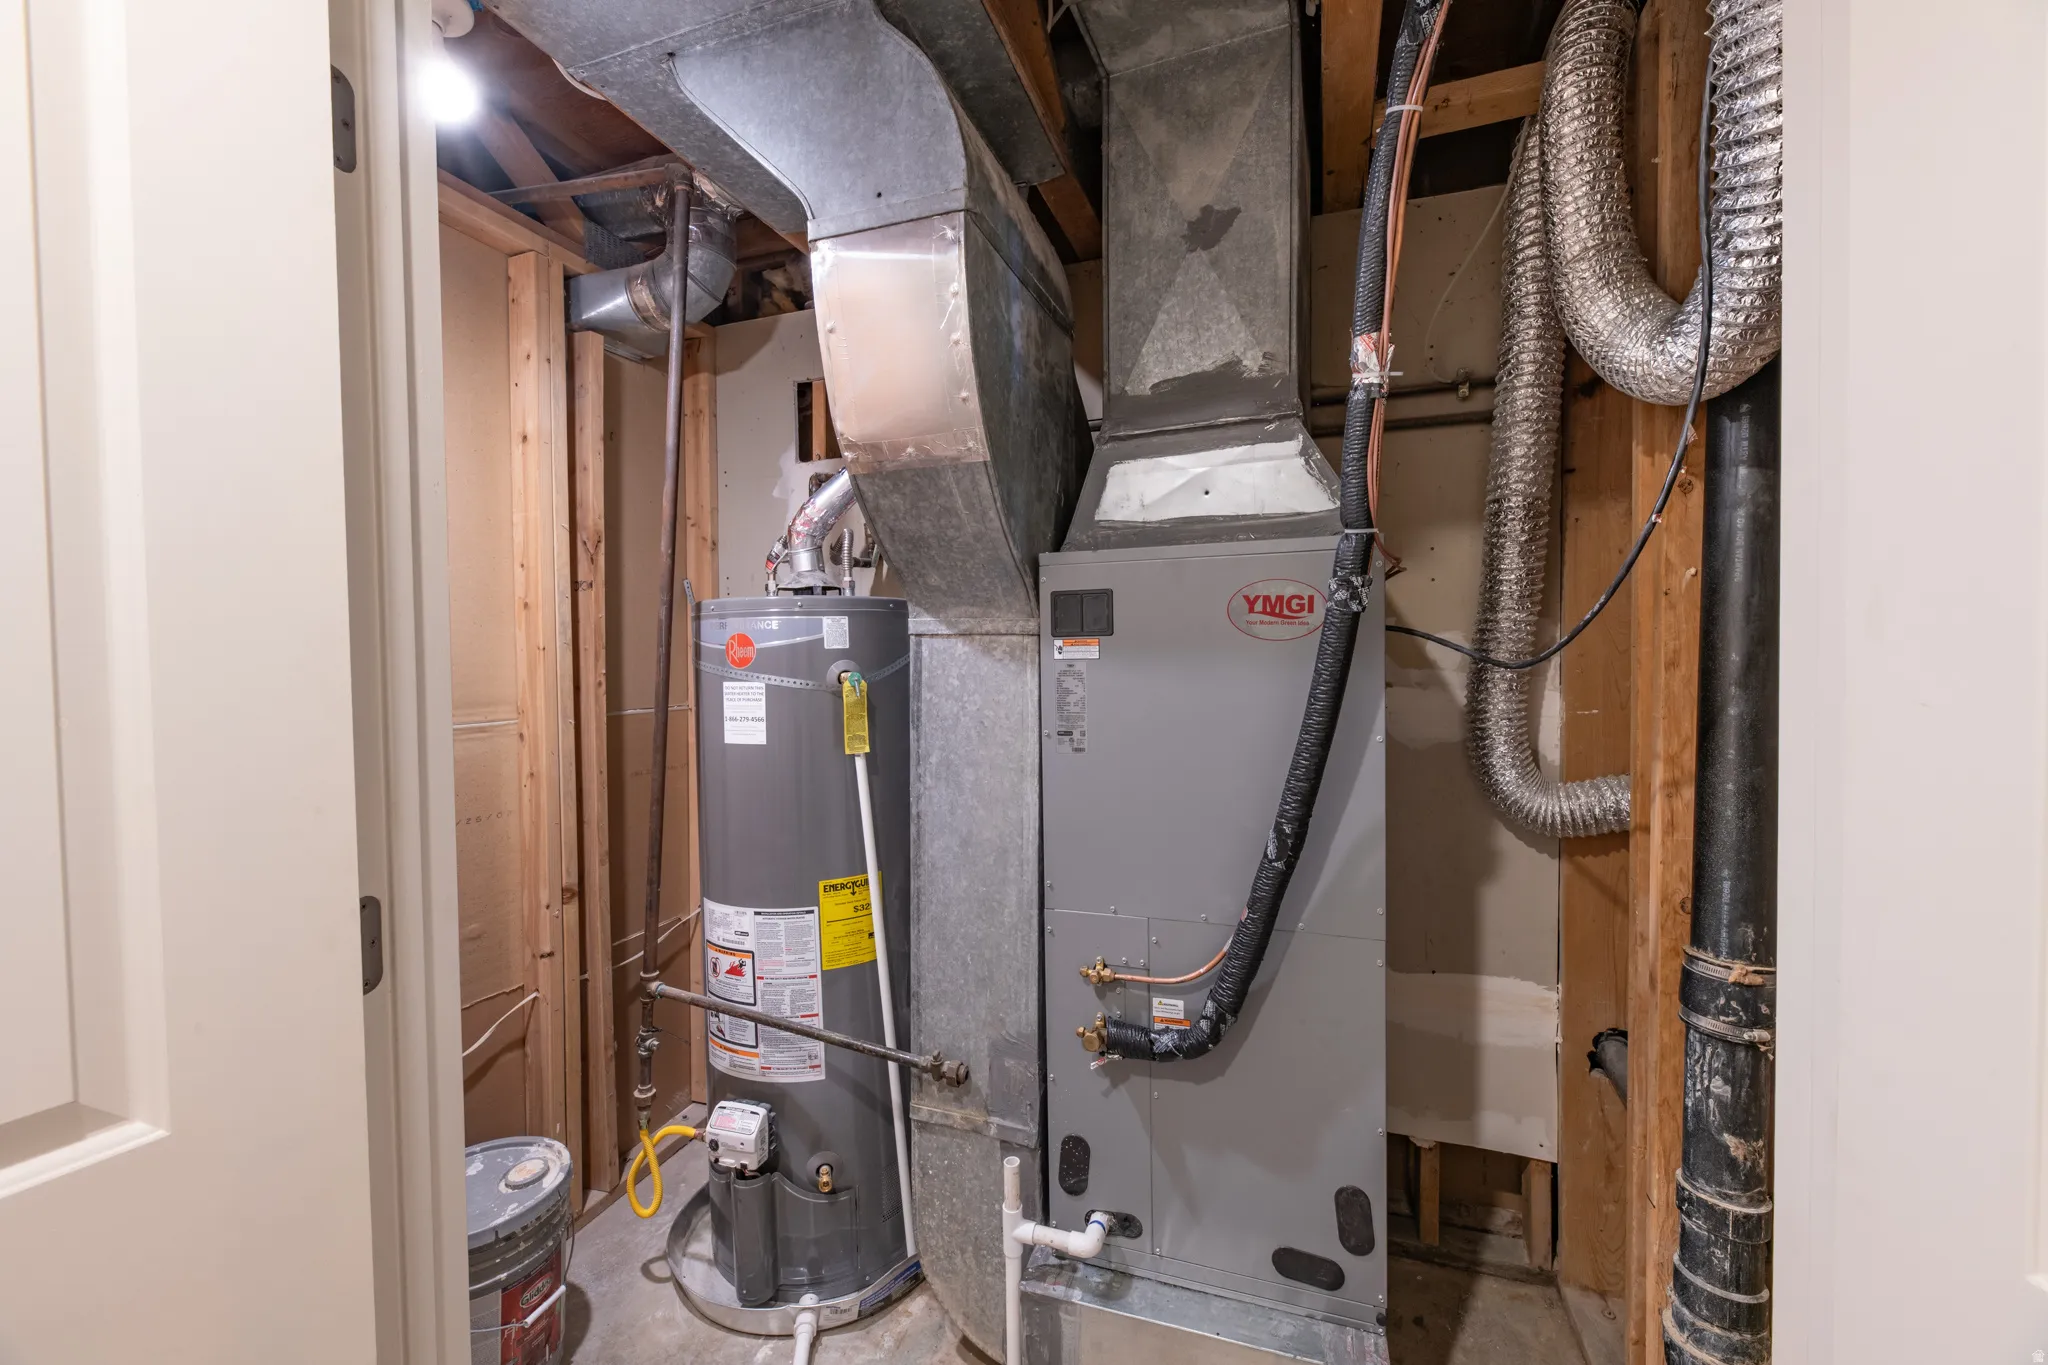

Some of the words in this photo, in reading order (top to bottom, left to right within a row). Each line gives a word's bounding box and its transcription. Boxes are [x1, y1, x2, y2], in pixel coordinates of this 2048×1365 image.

[1242, 594, 1314, 614] YMGI
[728, 634, 754, 664] Rheem
[823, 878, 869, 893] ENERGYGUI
